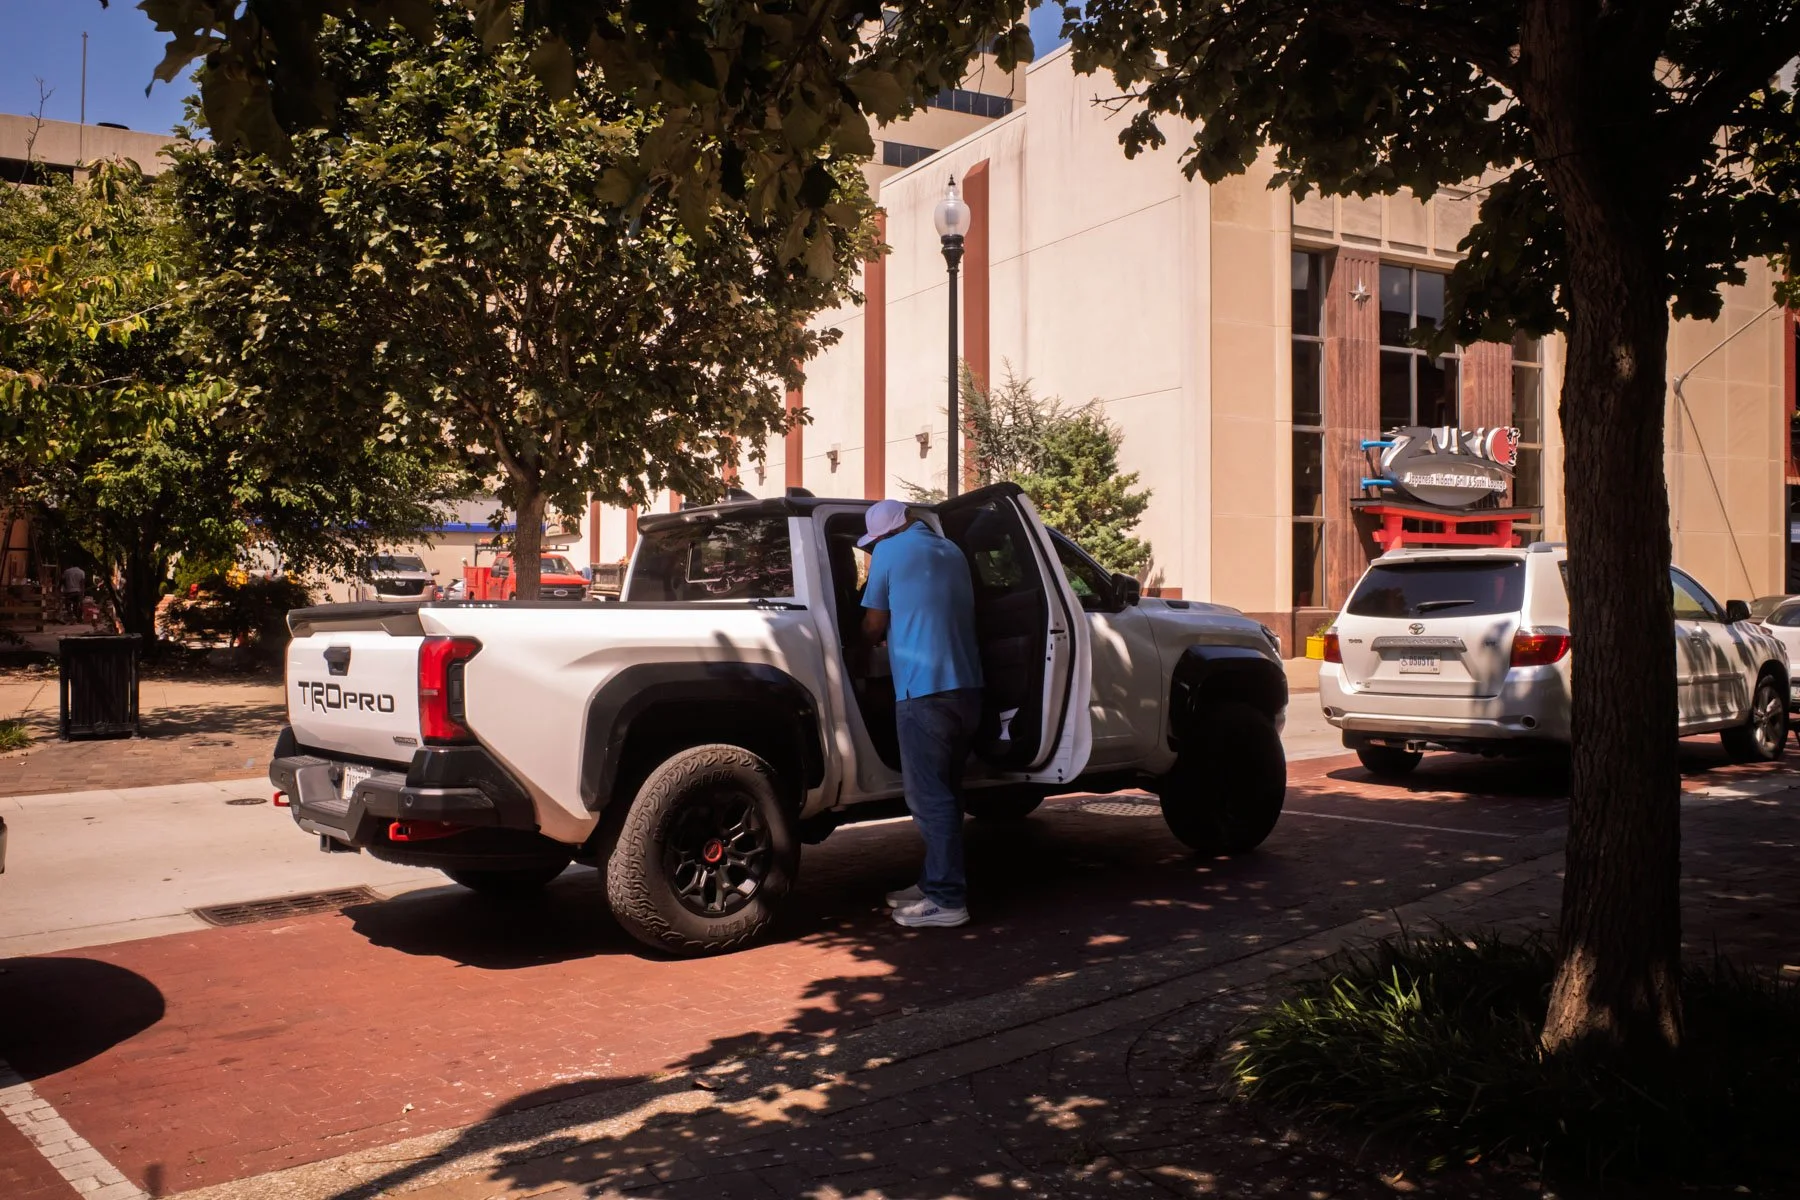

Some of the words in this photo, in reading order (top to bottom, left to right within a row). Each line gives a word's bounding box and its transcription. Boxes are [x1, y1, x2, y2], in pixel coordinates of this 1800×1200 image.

[1409, 473, 1434, 487] Japanese
[1473, 475, 1487, 488] Sushi
[1487, 478, 1506, 492] Lounge
